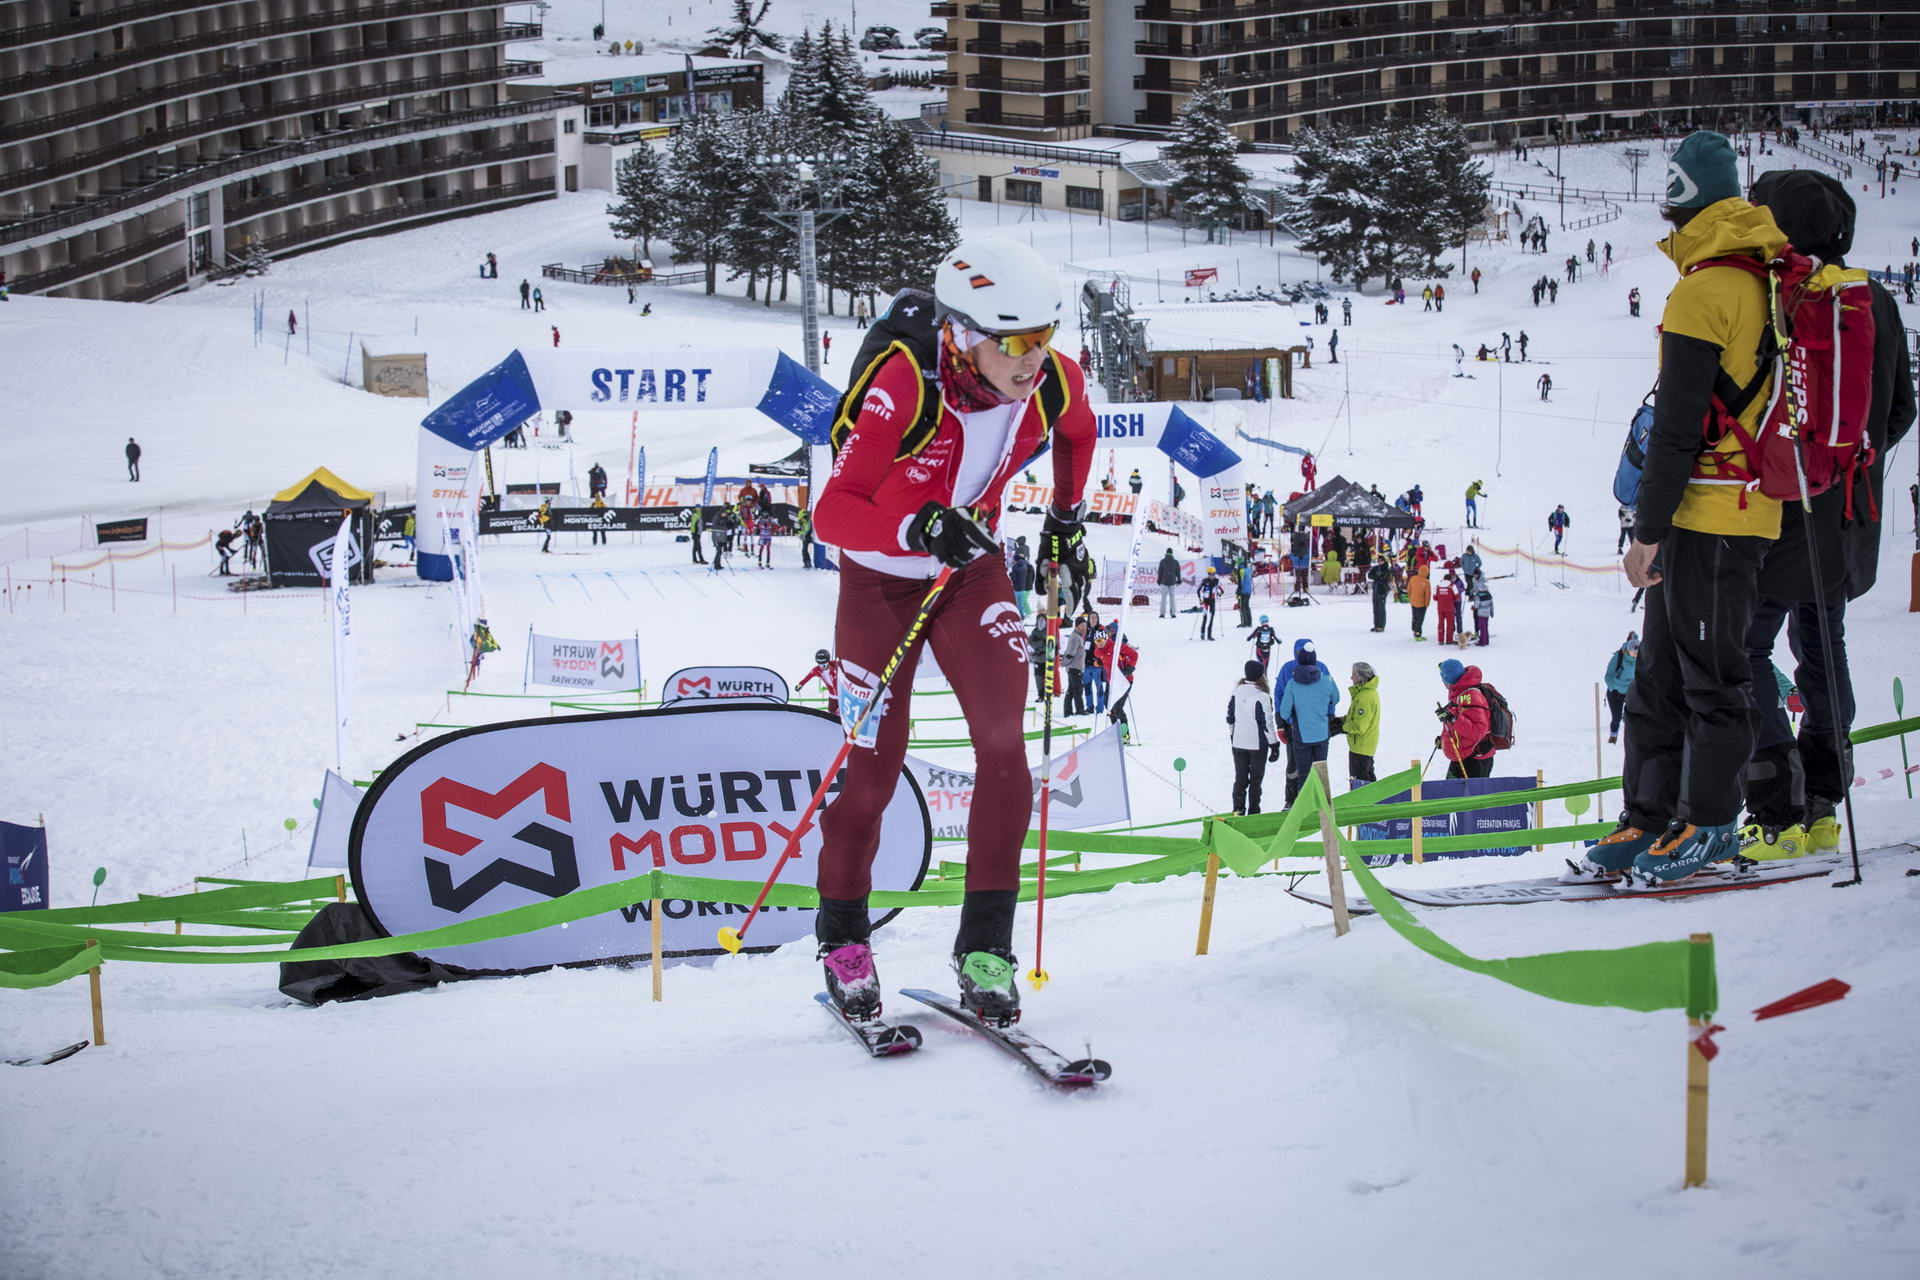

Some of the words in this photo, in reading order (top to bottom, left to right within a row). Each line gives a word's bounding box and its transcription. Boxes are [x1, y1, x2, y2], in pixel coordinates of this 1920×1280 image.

[591, 368, 712, 402] START
[431, 489, 469, 499] STIHL
[314, 510, 342, 518] vitamine
[1210, 509, 1242, 518] STIHL
[490, 520, 528, 528] MONTAGNE
[1336, 517, 1361, 525] HAUTES
[717, 681, 774, 693] WÜRTH
[843, 698, 861, 723] 51
[599, 768, 848, 823] WÜRTH
[1653, 856, 1700, 873] SCARPA
